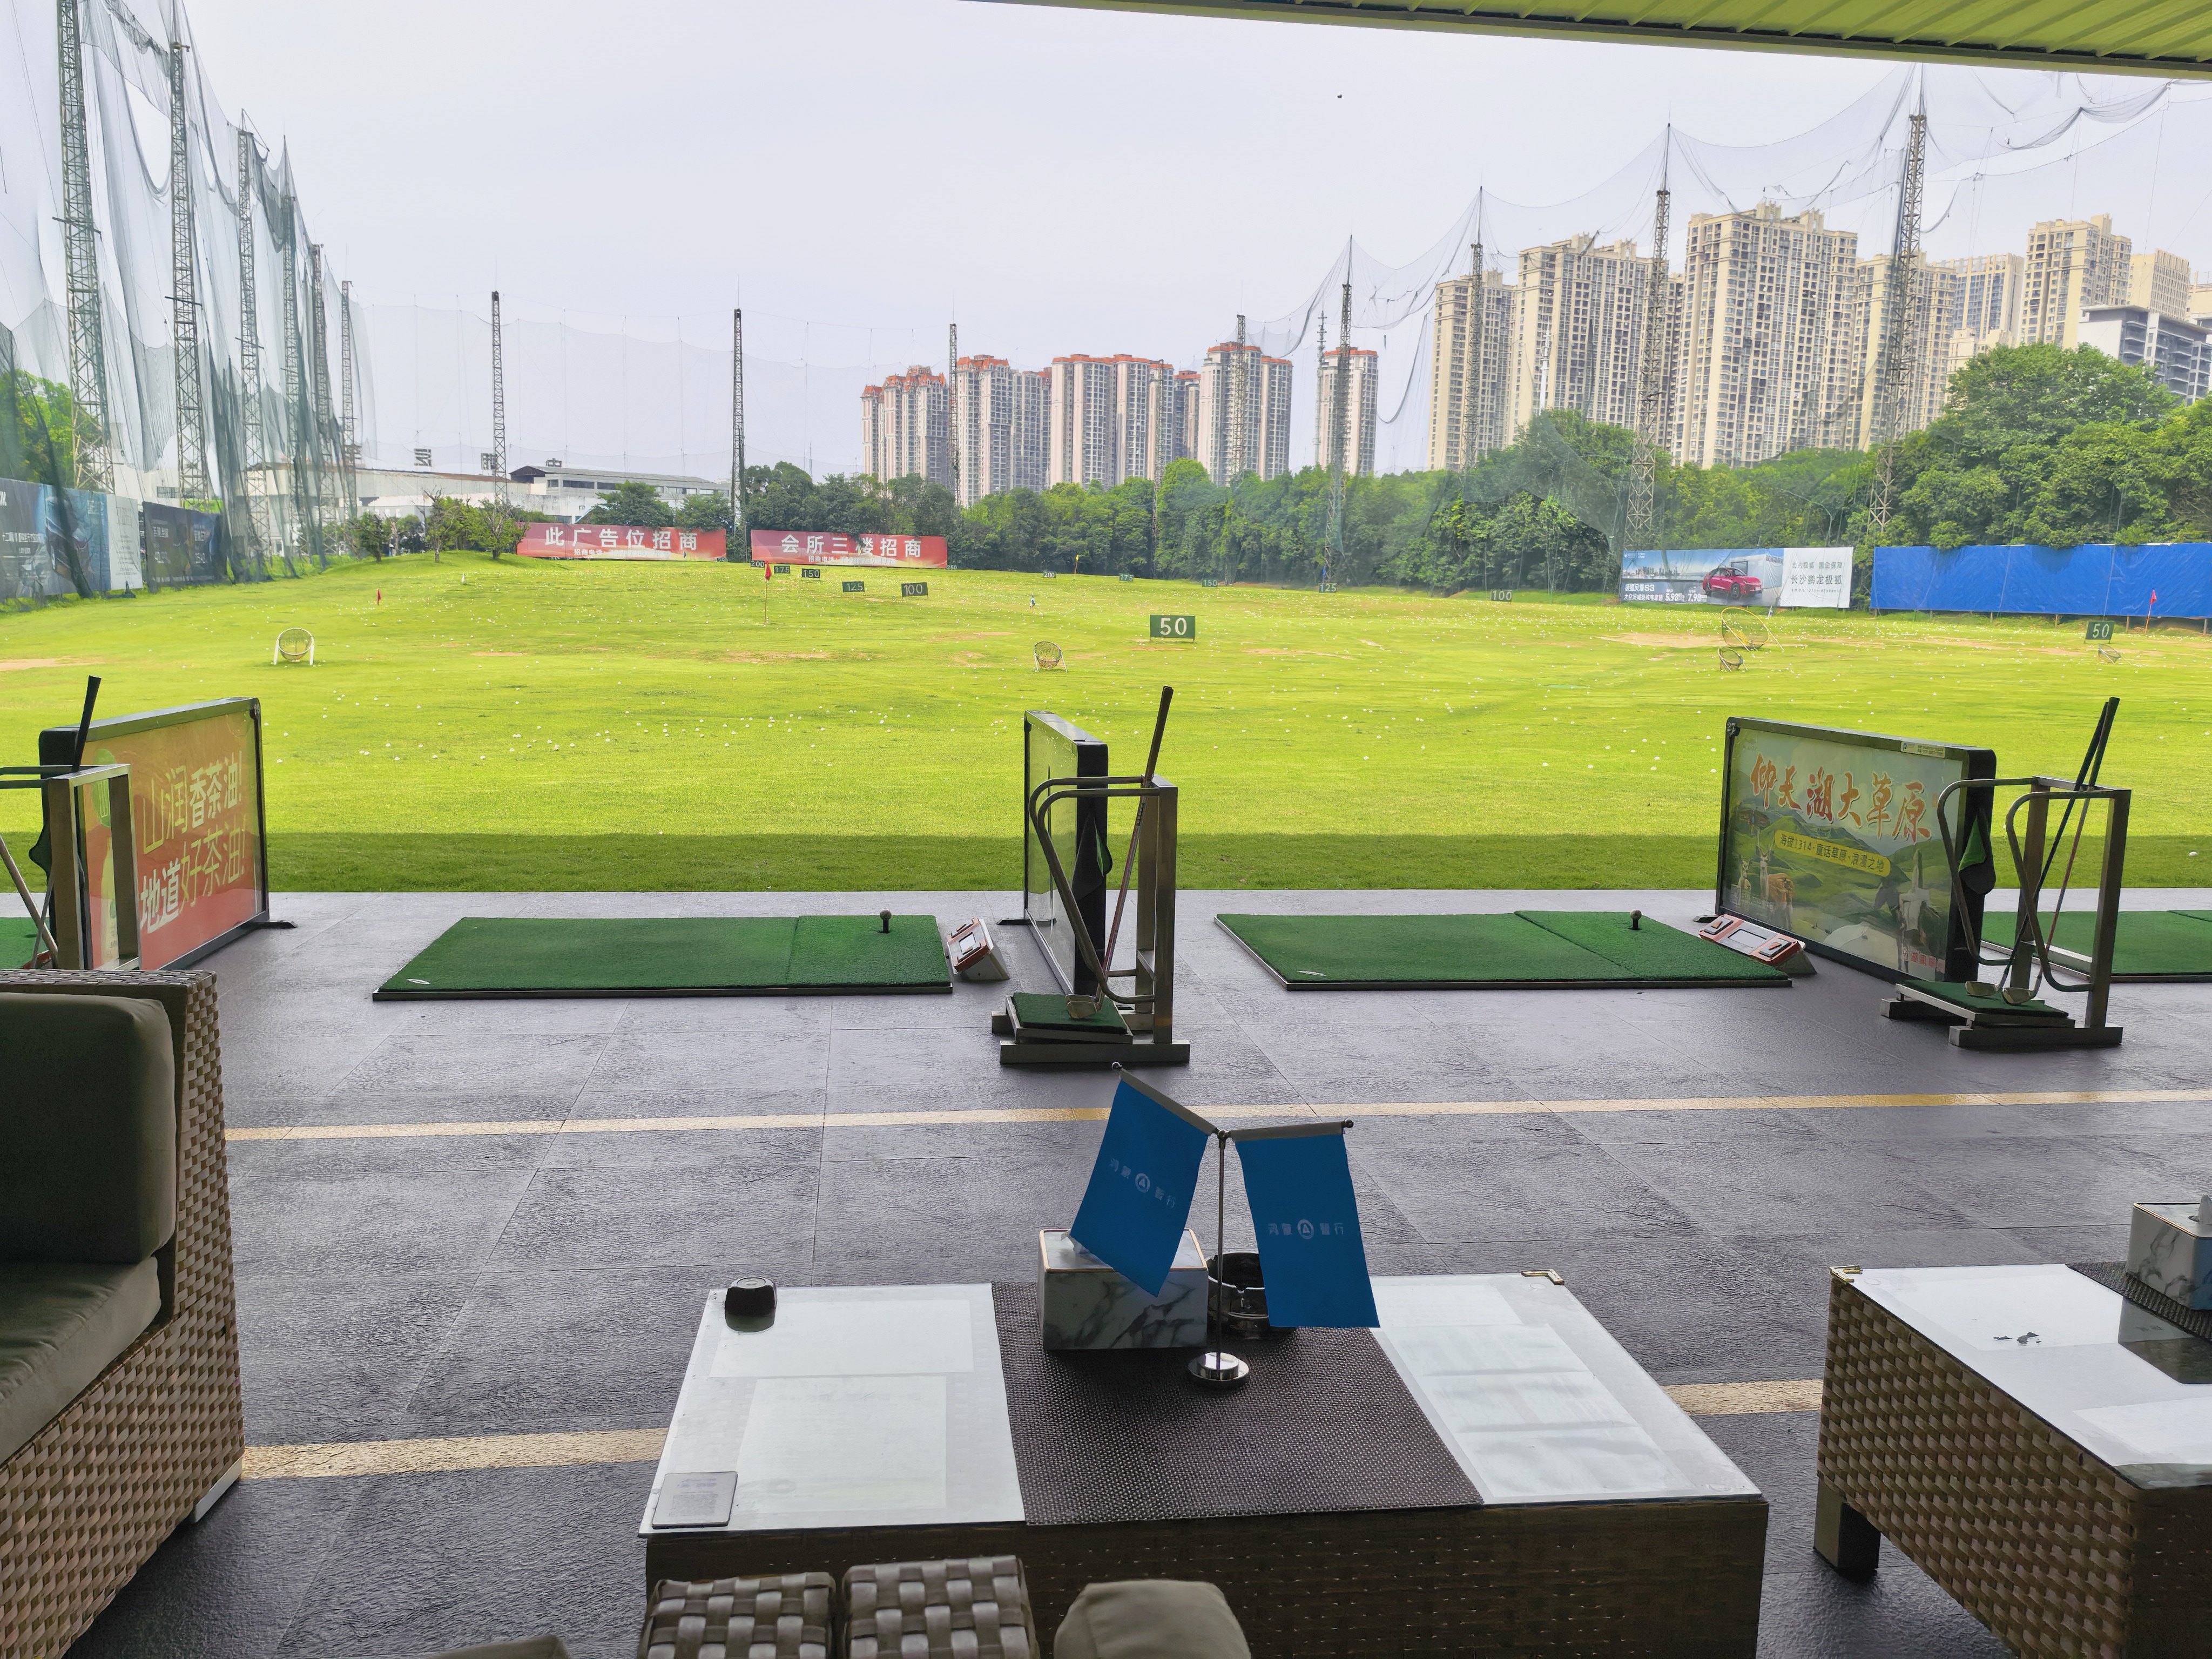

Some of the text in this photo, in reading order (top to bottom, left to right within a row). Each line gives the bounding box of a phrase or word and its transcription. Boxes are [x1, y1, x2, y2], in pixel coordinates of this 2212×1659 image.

[545, 527, 697, 550] 此广告位招商
[781, 534, 921, 558] 会所三楼招商
[804, 569, 820, 577] 150
[847, 582, 864, 591] 125
[1203, 579, 1218, 587] 150
[1319, 583, 1337, 592] 125
[903, 584, 923, 596] 100
[1493, 590, 1512, 600] 100
[1160, 617, 1187, 635] 50
[2093, 624, 2109, 638] 50
[1750, 752, 1932, 842] 仰天湖大草原
